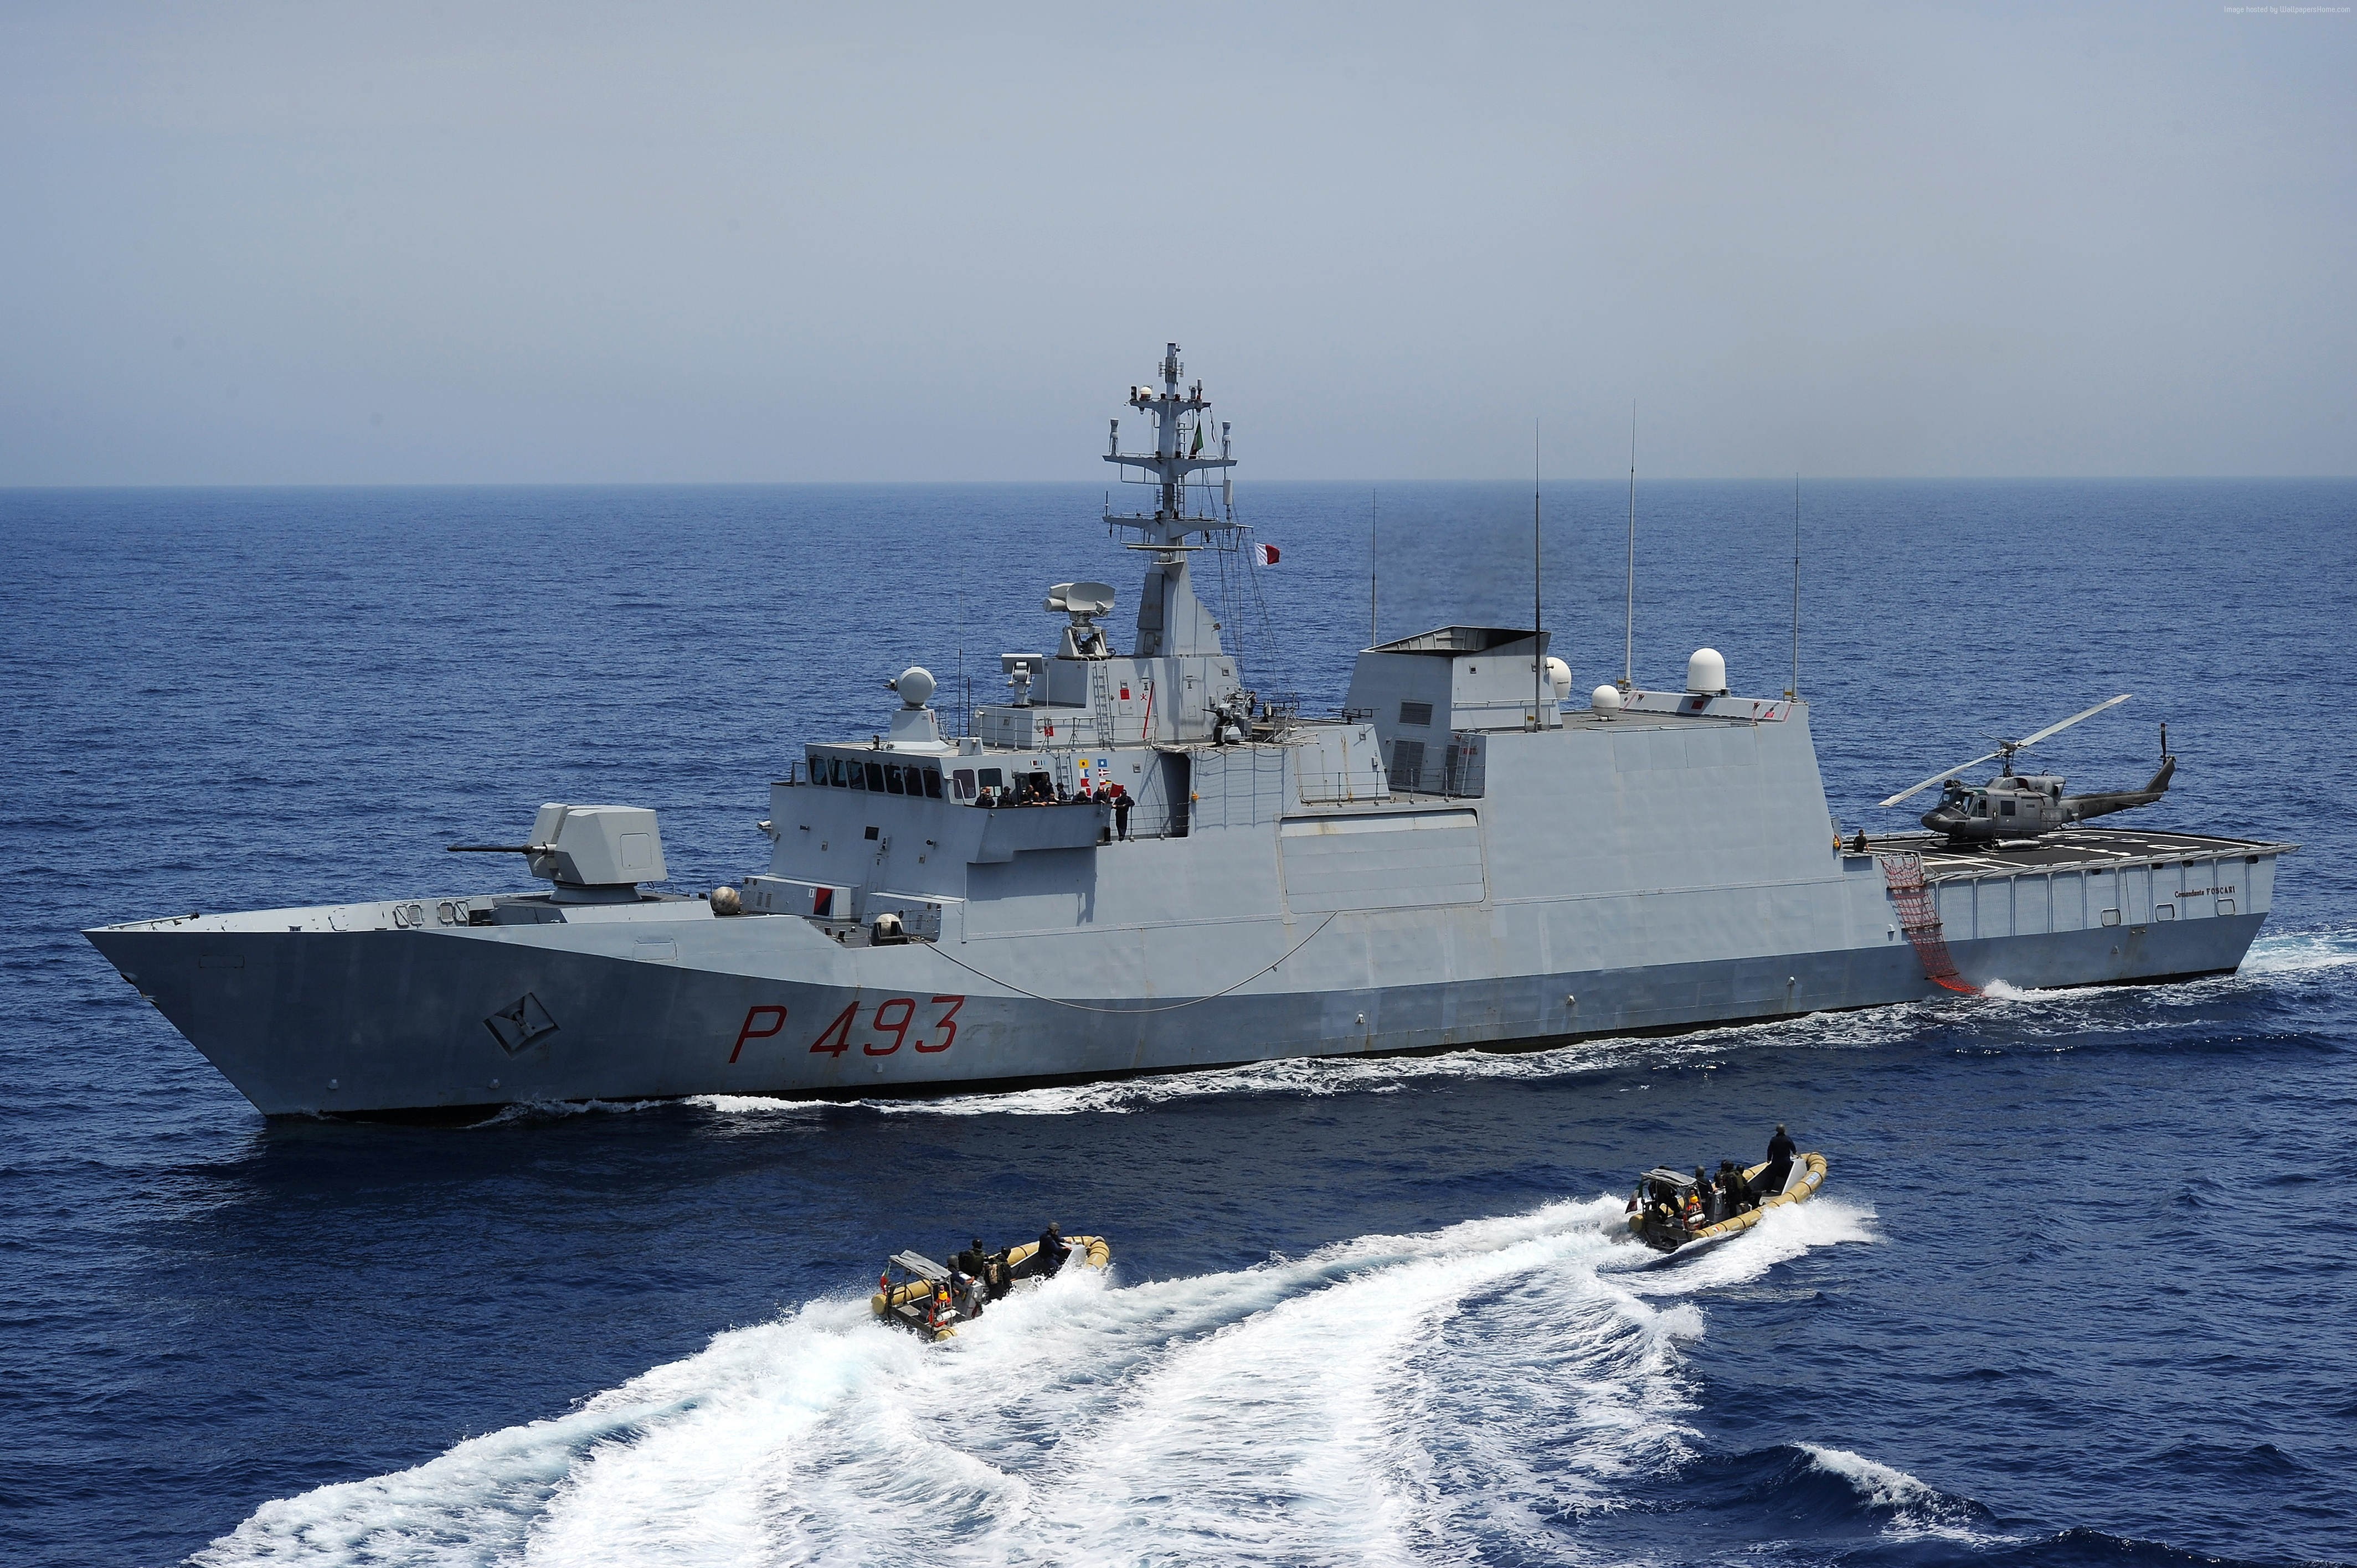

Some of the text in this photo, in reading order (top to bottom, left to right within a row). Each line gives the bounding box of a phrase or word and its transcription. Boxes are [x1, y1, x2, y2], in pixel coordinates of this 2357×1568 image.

[2206, 886, 2235, 895] FOSCARI
[728, 995, 966, 1064] P 493
